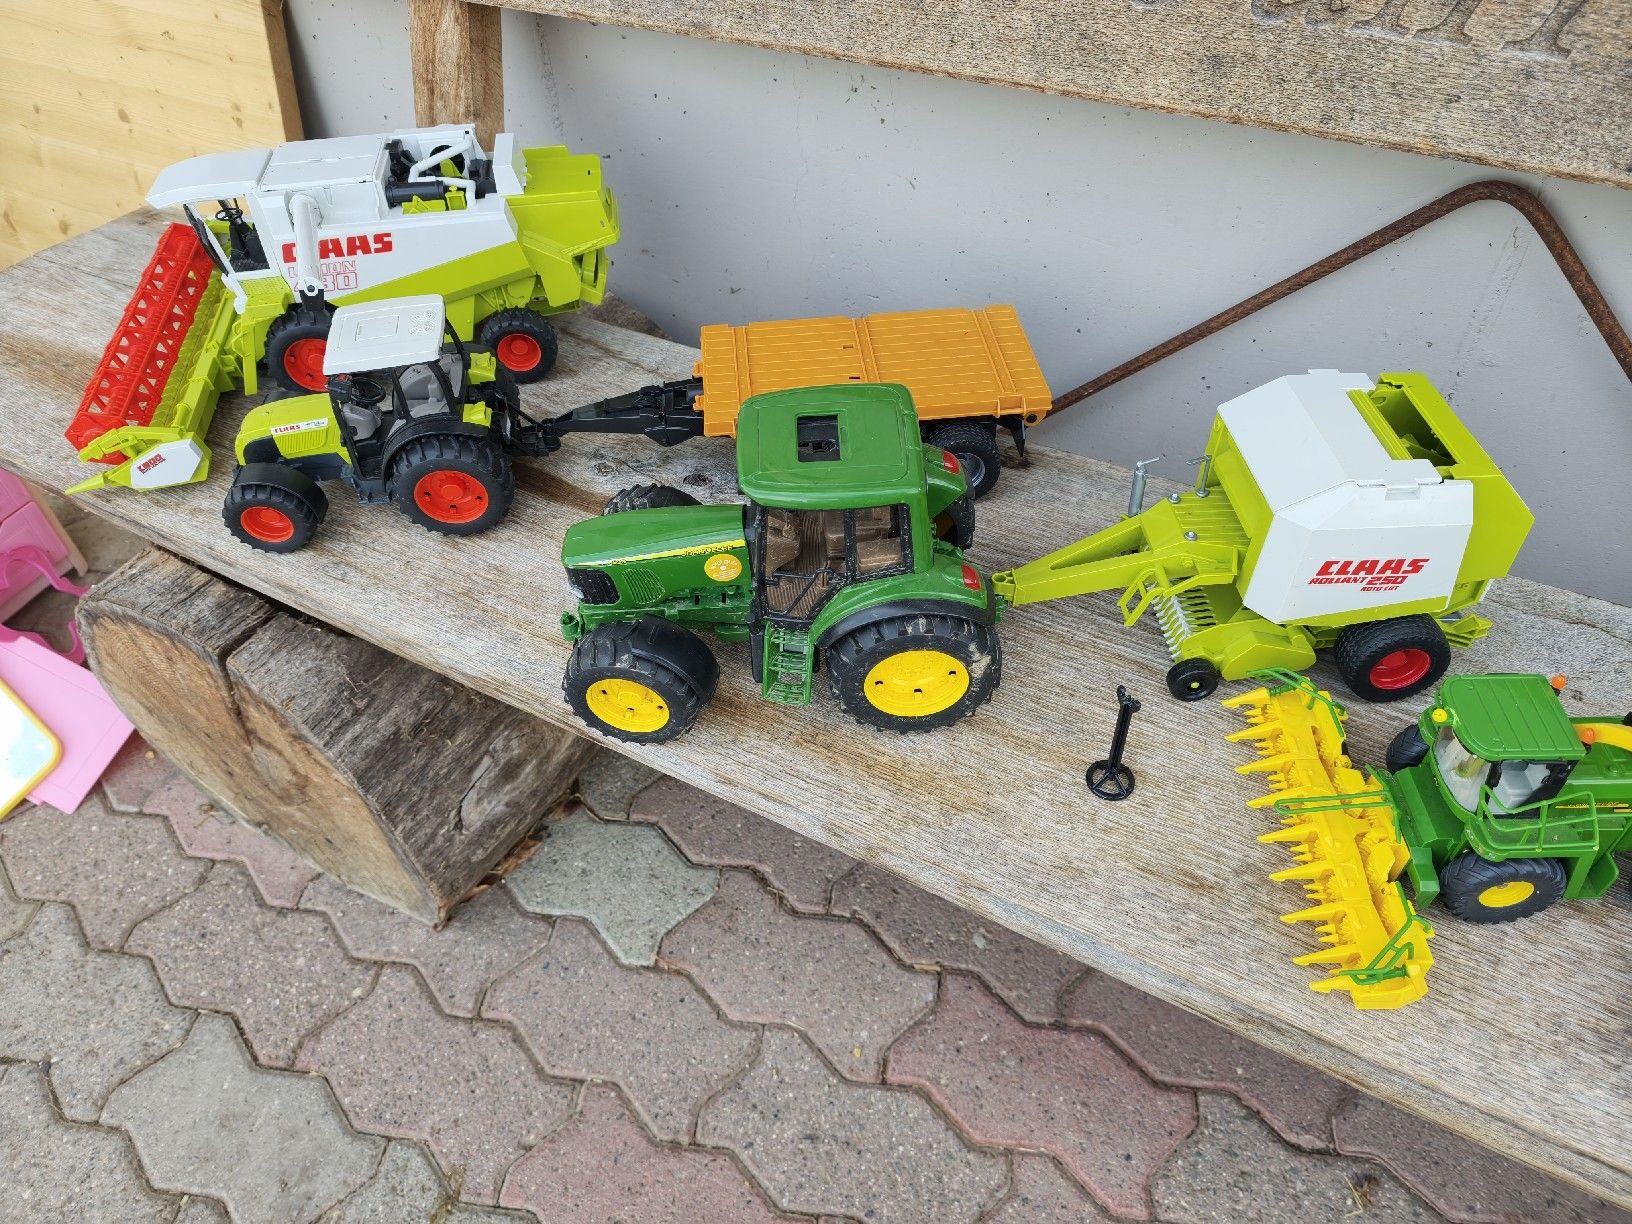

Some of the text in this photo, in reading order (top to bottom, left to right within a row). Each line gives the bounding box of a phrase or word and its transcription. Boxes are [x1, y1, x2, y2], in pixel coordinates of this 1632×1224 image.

[281, 232, 393, 264] CAAS
[288, 260, 357, 278] LION
[274, 424, 301, 434] CLAAS
[1315, 558, 1431, 577] CLAAS
[1308, 575, 1409, 586] ROLLANT 250
